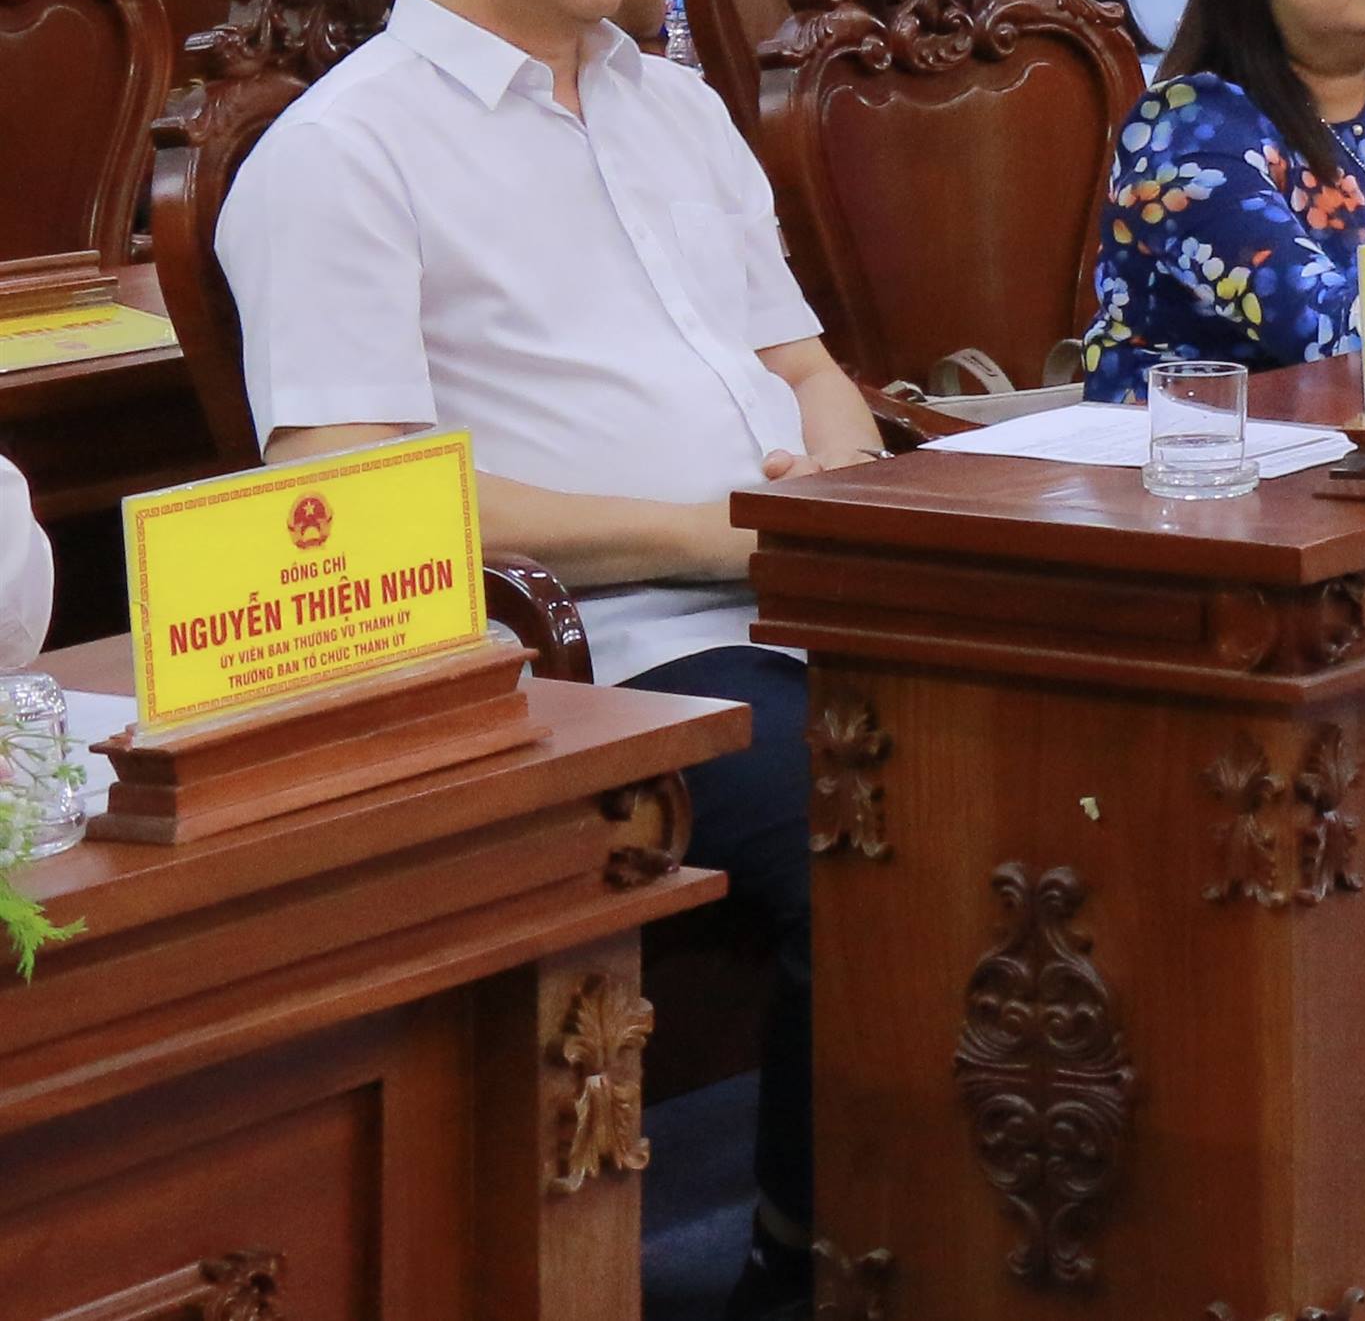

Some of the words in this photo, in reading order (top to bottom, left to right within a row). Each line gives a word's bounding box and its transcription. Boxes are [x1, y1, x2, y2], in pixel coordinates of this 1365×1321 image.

[323, 551, 347, 575] CHÍ
[169, 590, 283, 657] NGUYỄN
[290, 575, 372, 626] THIỆN
[382, 557, 455, 605] NHƠN
[238, 647, 265, 665] VIÊN
[268, 641, 290, 658] BAN
[340, 624, 356, 639] VỤ
[277, 661, 300, 677] BAN
